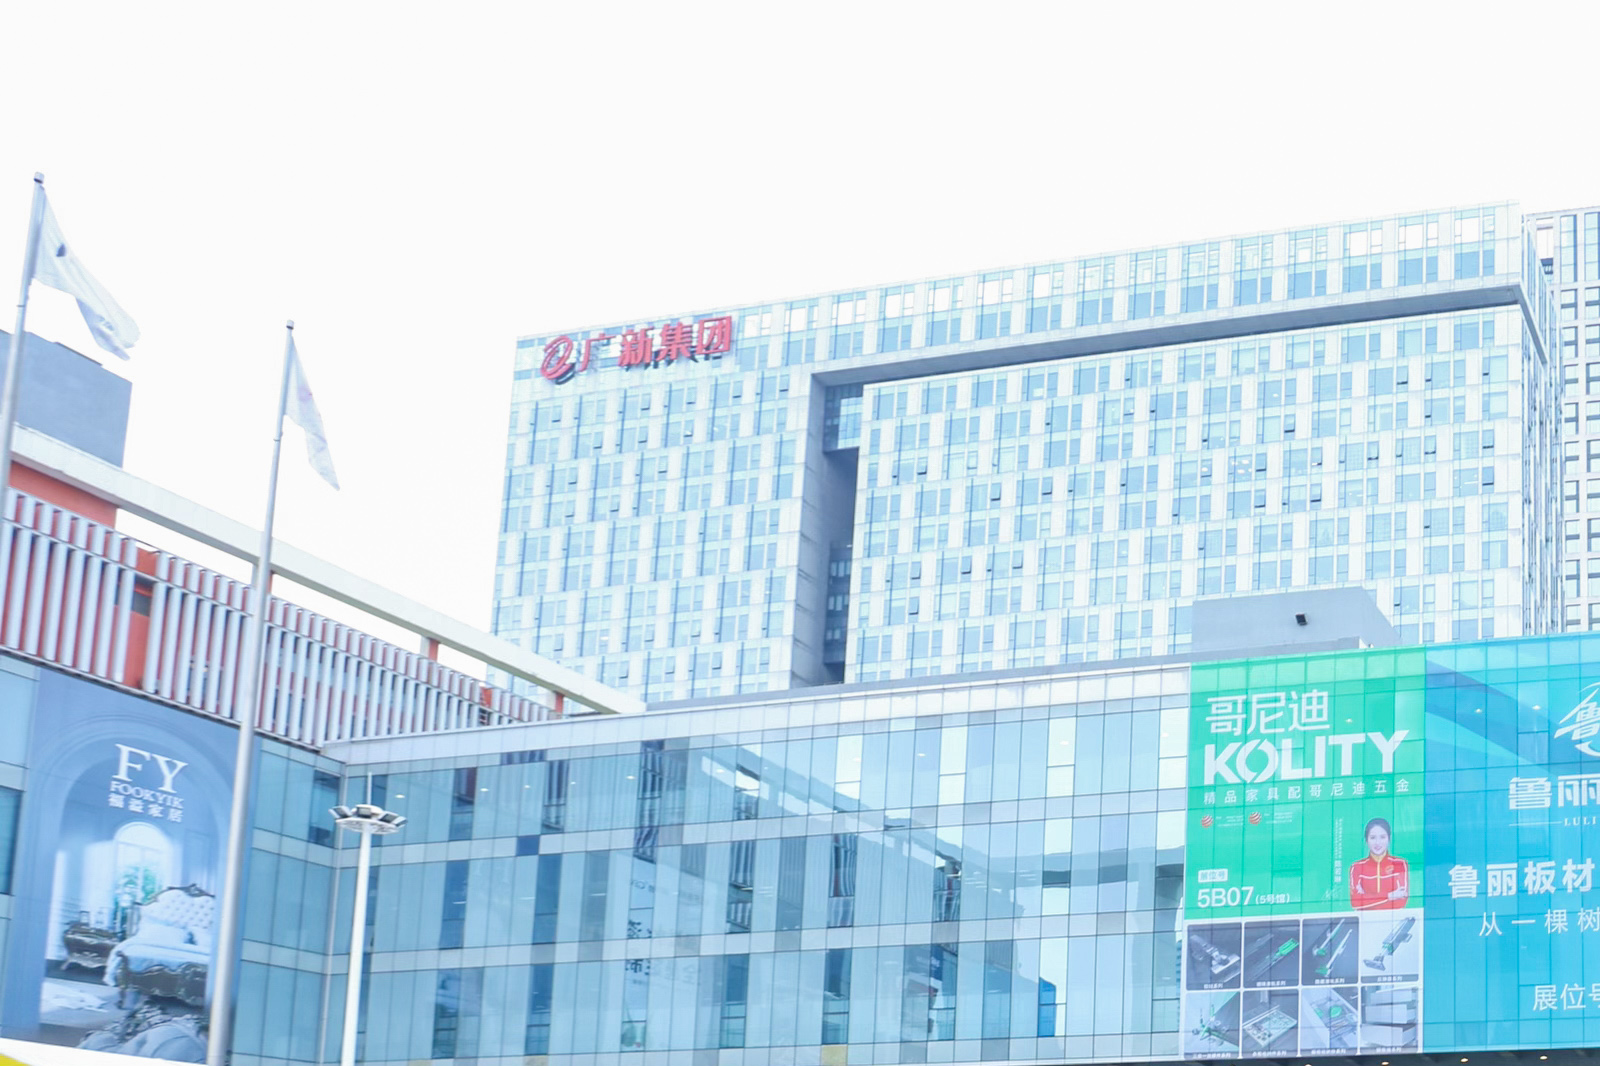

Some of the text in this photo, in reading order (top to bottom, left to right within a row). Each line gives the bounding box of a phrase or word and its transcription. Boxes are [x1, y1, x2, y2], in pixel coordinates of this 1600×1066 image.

[578, 316, 732, 373] 广新集团
[1206, 689, 1330, 736] 哥尼迪
[112, 743, 189, 793] FY
[1203, 730, 1410, 785] KOLITY
[1564, 816, 1597, 827] LULI
[1198, 886, 1254, 908] 5B07
[1448, 858, 1595, 899] 鲁丽板材
